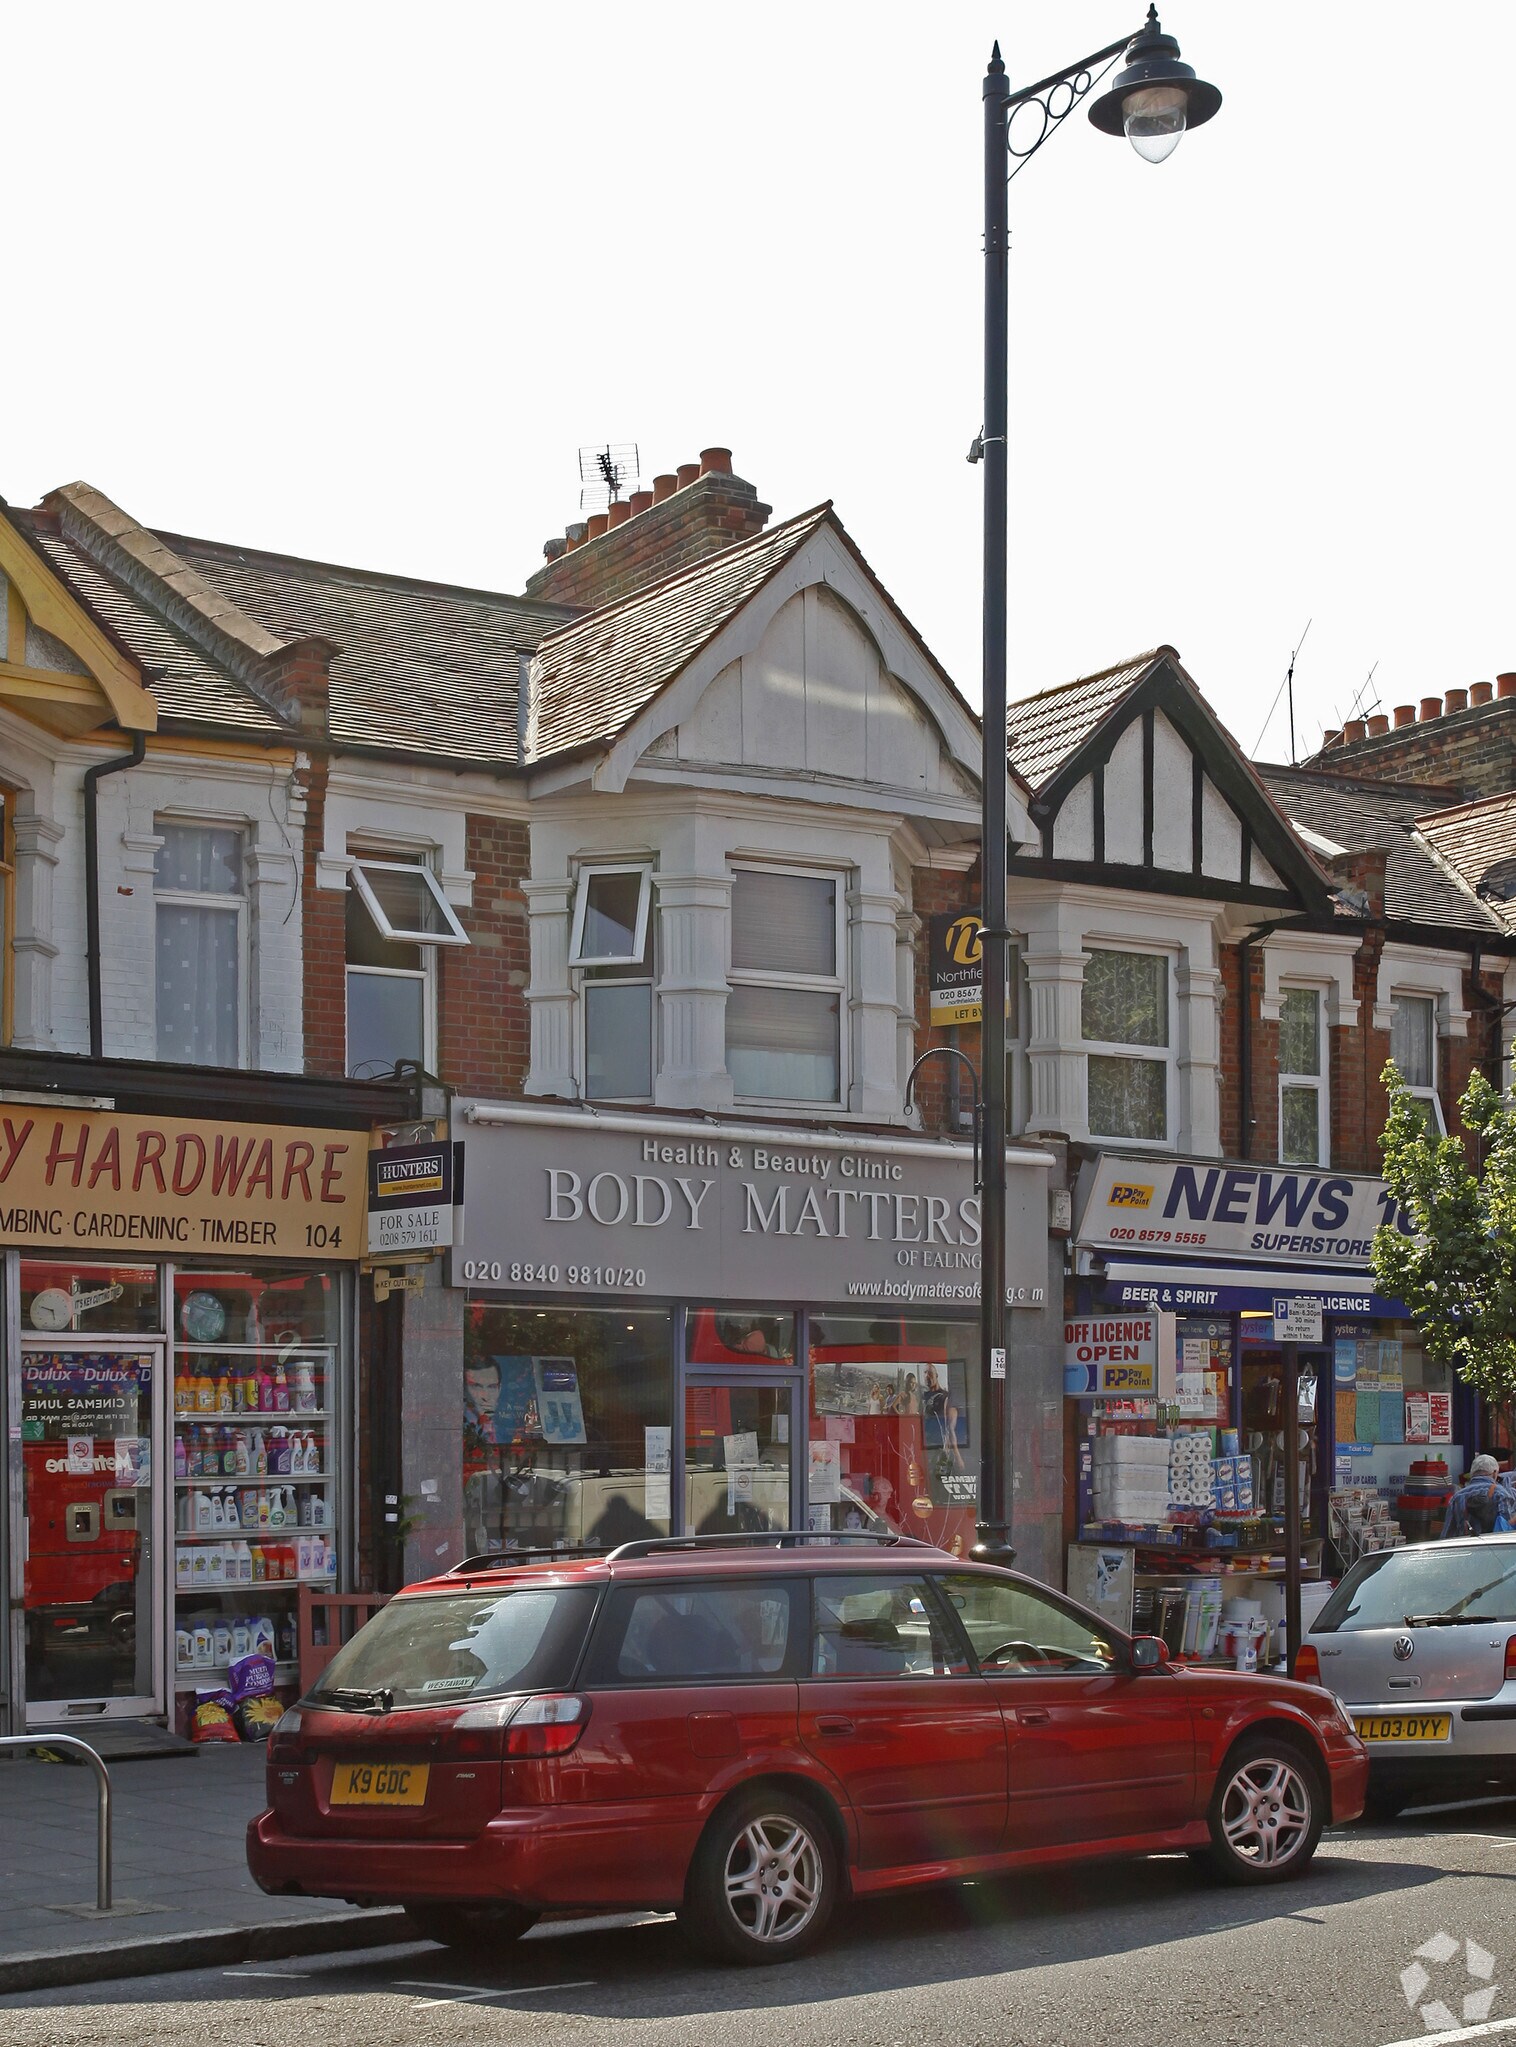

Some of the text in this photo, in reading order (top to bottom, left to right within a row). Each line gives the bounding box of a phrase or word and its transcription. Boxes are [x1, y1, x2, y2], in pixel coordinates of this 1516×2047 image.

[936, 968, 982, 983] Northfie
[940, 991, 955, 1000] 020
[958, 988, 977, 998] 8567
[955, 1009, 969, 1019] LET
[45, 1121, 349, 1203] HARDWARE
[642, 1139, 904, 1181] Health & Beauty Clinic
[382, 1160, 439, 1179] HUNTERS
[1130, 1197, 1149, 1206] Point
[1162, 1166, 1353, 1230] NEWS
[544, 1168, 981, 1247] BODY MATTERS
[380, 1211, 440, 1230] FOR SALE
[73, 1211, 188, 1241] GARDENING
[200, 1219, 276, 1245] TIMBER
[305, 1224, 342, 1248] 104
[380, 1229, 438, 1246] 0208 579 1611
[1110, 1228, 1207, 1244] 020 8579 5555
[1251, 1232, 1373, 1256] SUPERSTORE
[897, 1249, 981, 1270] OF EALING
[464, 1260, 646, 1287] 020 8840 9810/20
[380, 1278, 417, 1288] KEY CUTTING
[1122, 1287, 1218, 1304] BEER & SPIRIT
[1321, 1296, 1371, 1311] LICENCE
[1278, 1302, 1286, 1317] P
[1064, 1321, 1151, 1343] OFF LICENCE
[1076, 1345, 1139, 1362] OPEN
[26, 1367, 72, 1381] Dulux
[84, 1368, 129, 1381] Dulux
[1128, 1369, 1143, 1378] Pay
[1128, 1377, 1150, 1386] Point
[1343, 1475, 1377, 1484] TOP UP CARDS
[427, 1678, 471, 1689] WESTAWAY
[1358, 1719, 1442, 1738] LL03 OYY
[349, 1768, 410, 1794] K9 GDC
